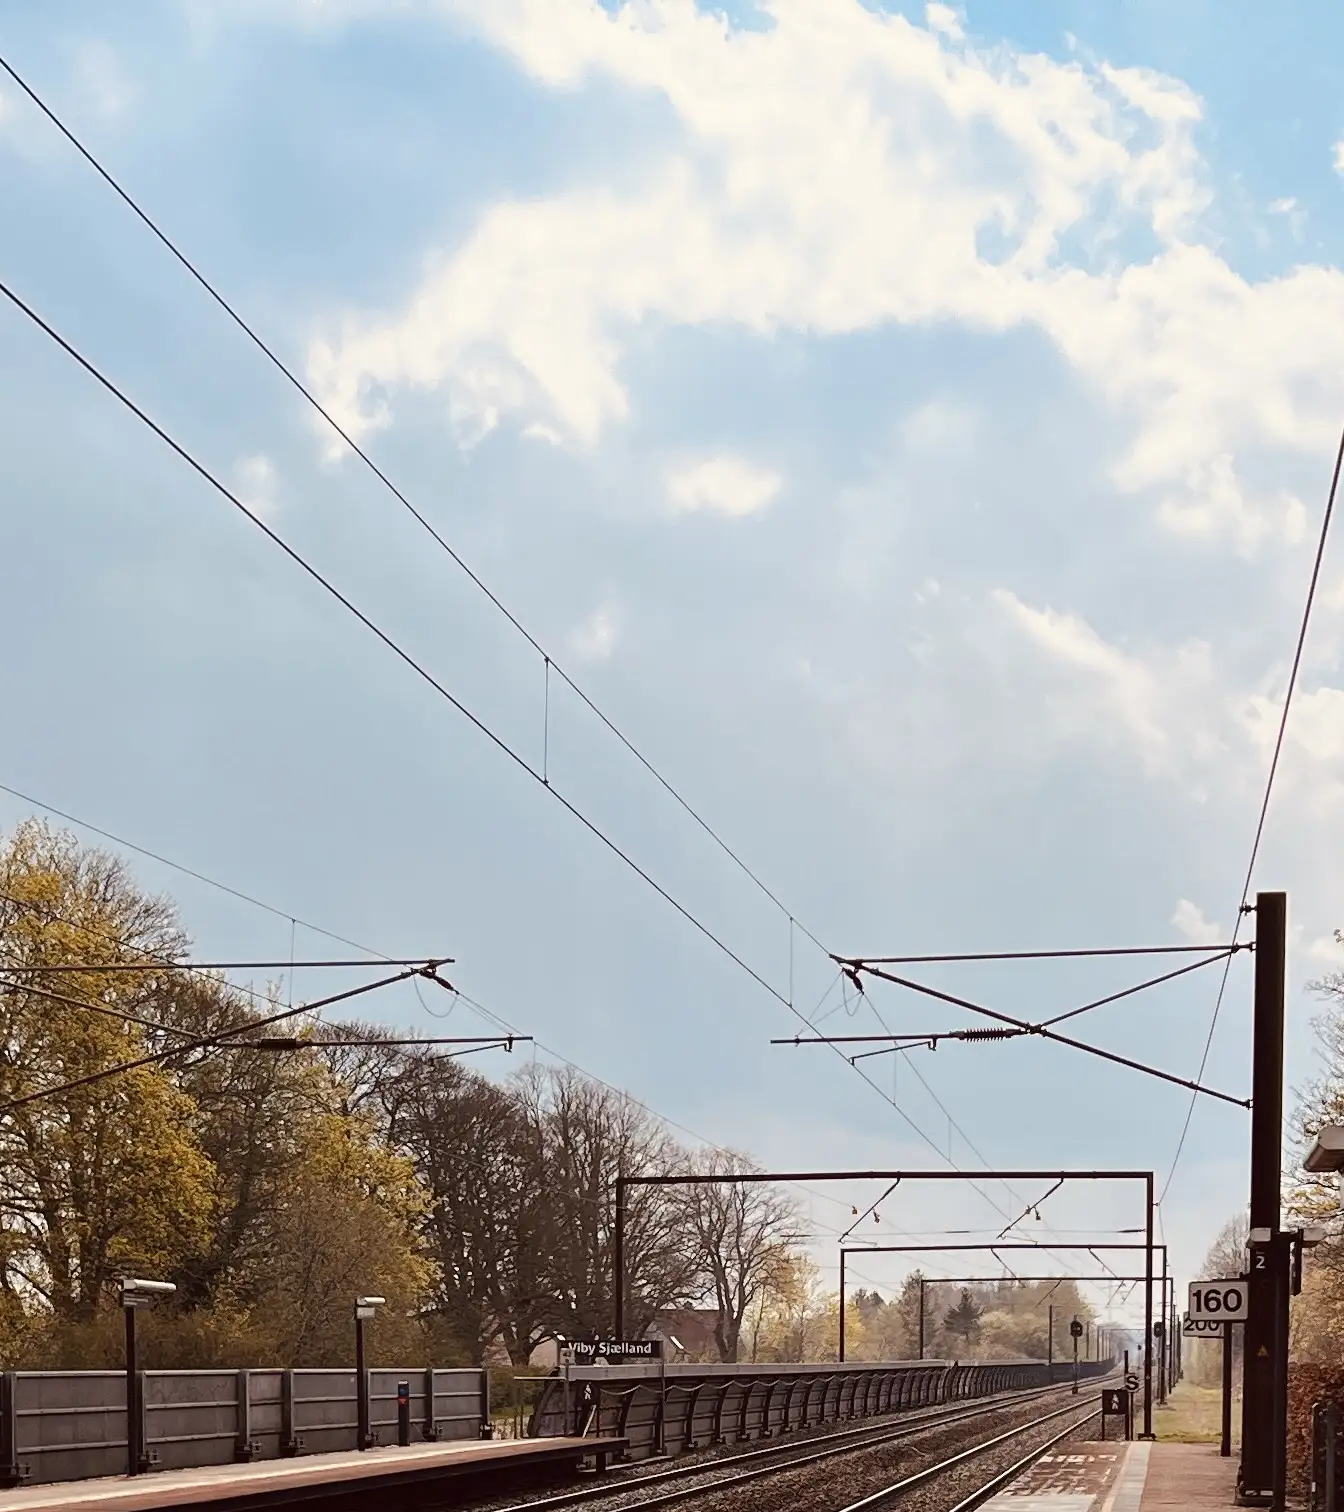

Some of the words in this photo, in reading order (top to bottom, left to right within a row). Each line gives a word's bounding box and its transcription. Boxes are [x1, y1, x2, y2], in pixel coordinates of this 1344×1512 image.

[1256, 1256, 1266, 1269] 2
[1192, 1288, 1243, 1313] 160
[1184, 1318, 1220, 1332] 200
[568, 1342, 596, 1356] Viby
[598, 1342, 652, 1356] Sjælland
[1126, 1375, 1139, 1391] S
